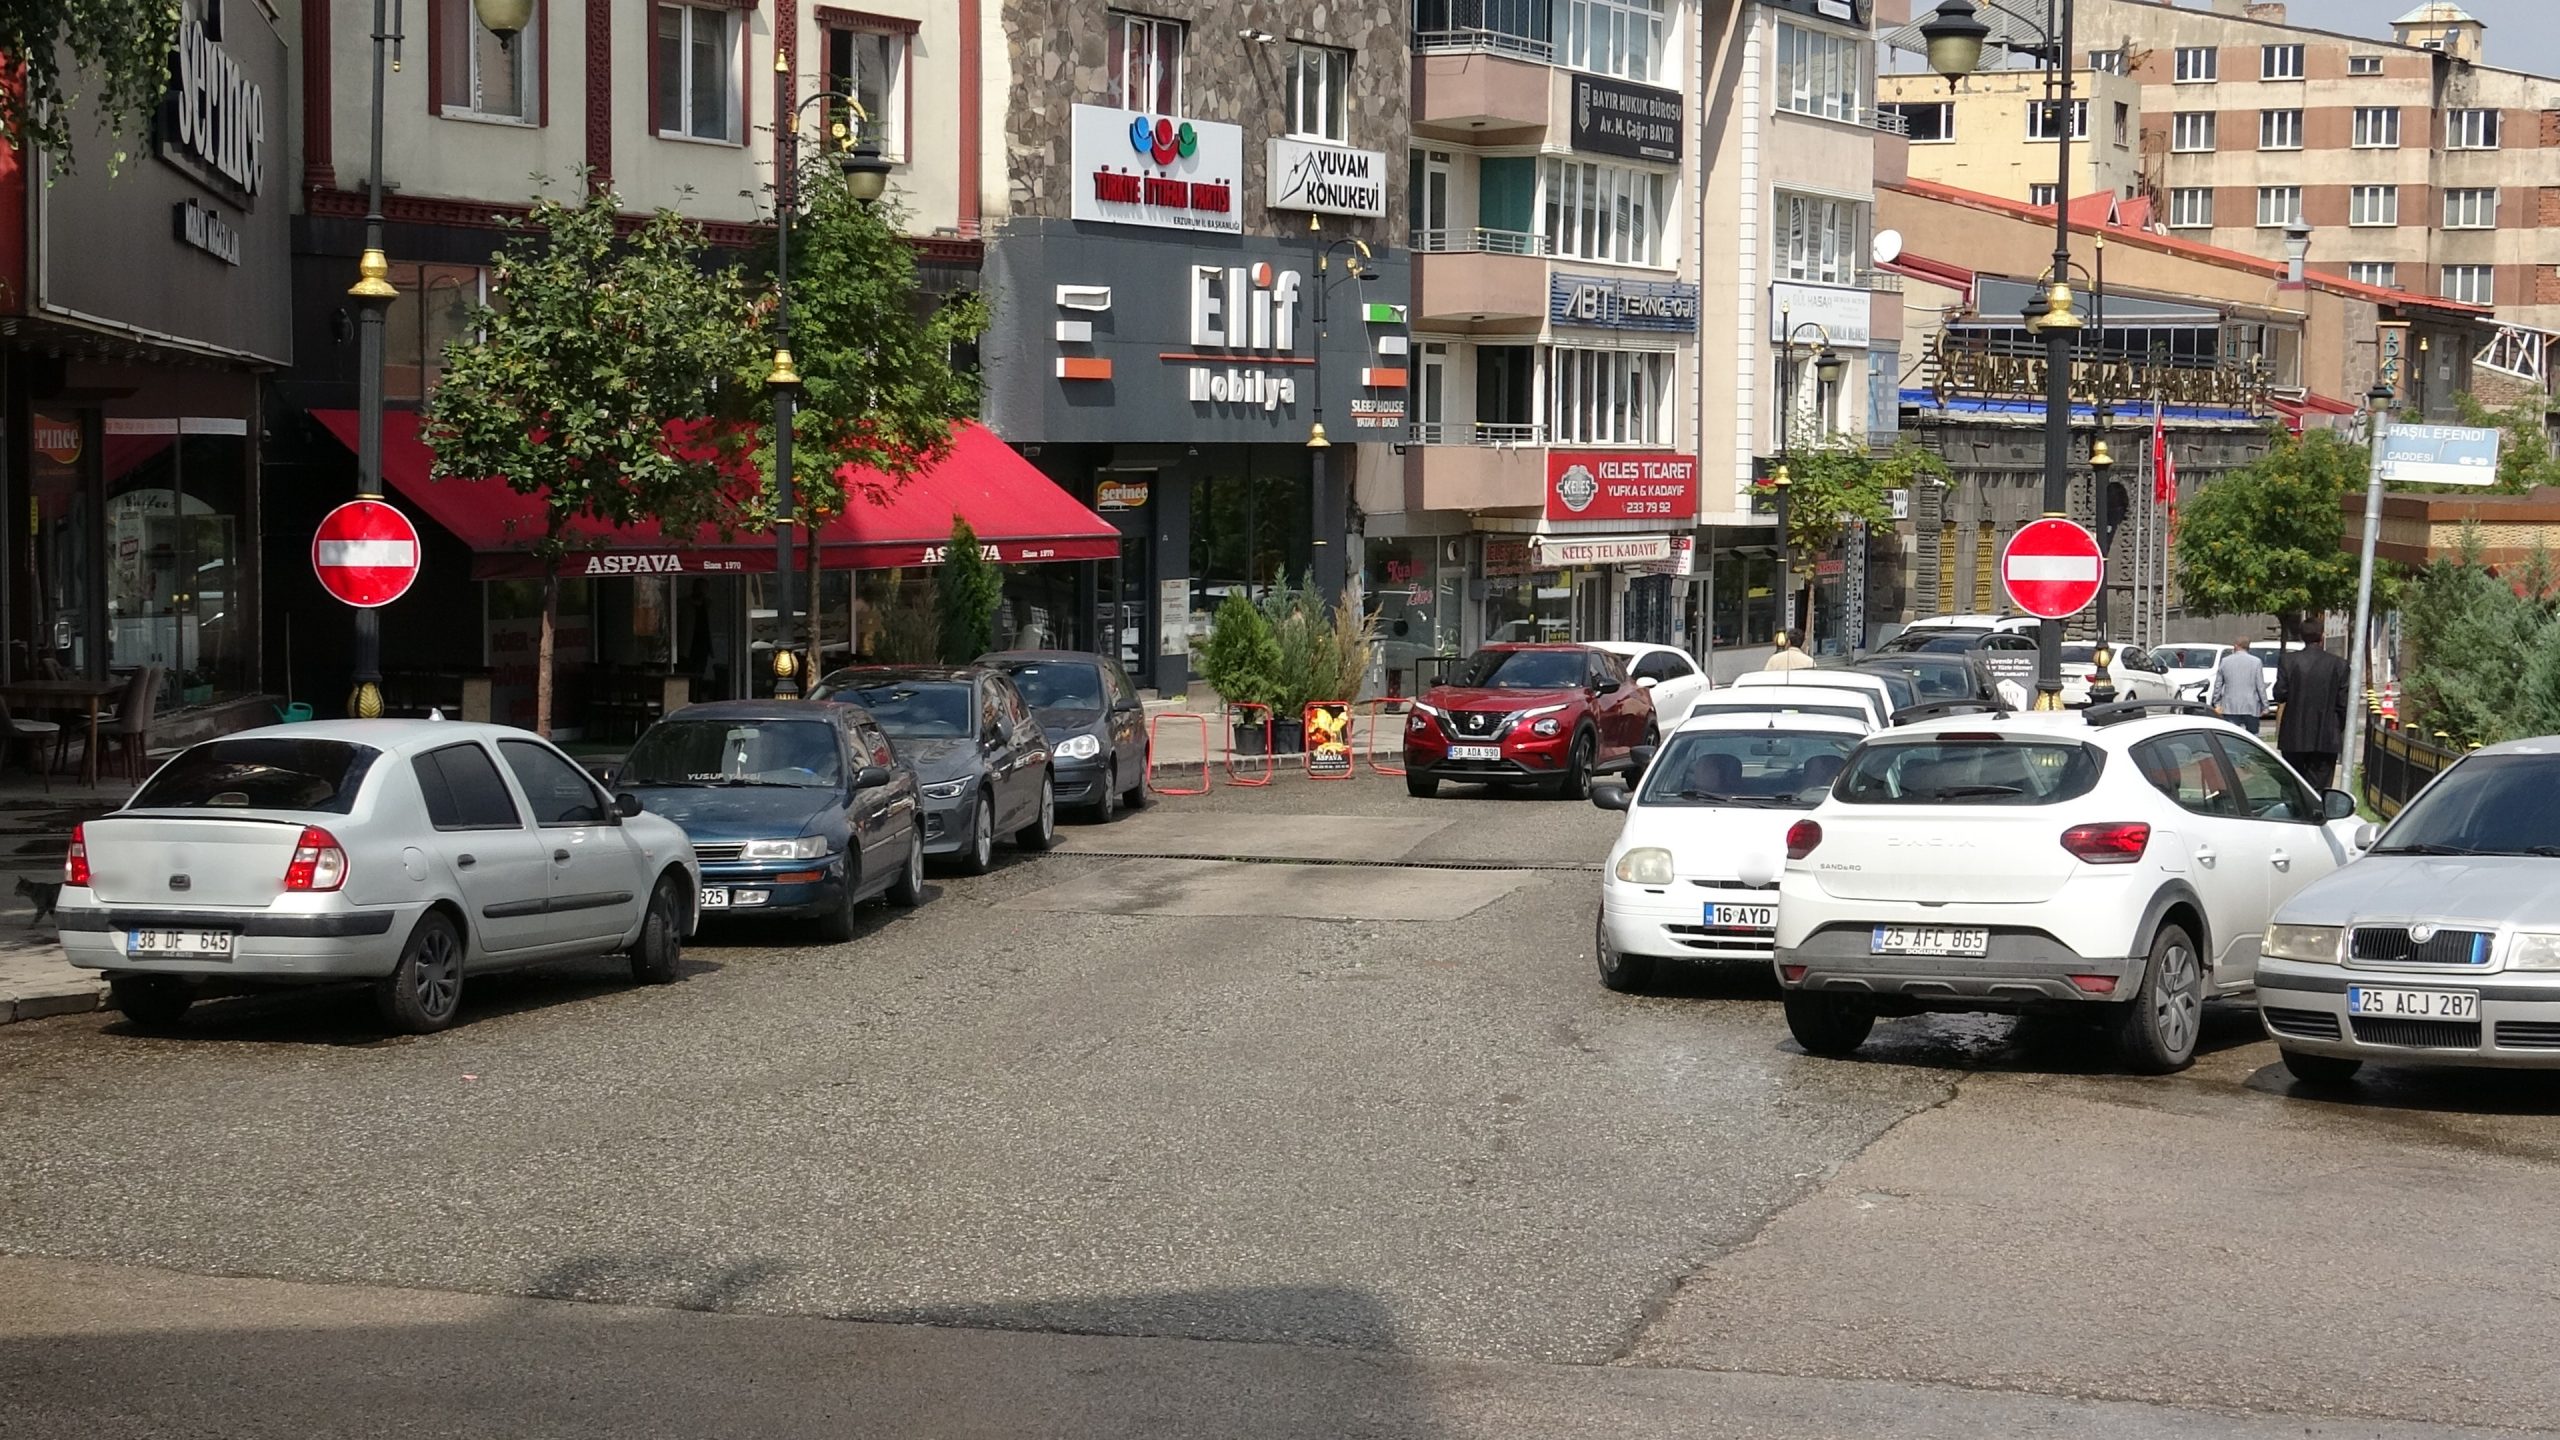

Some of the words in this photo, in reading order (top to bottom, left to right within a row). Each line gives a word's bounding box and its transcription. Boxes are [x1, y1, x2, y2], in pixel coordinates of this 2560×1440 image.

[179, 0, 264, 198] serince
[1592, 89, 1618, 110] BAYIR
[1620, 94, 1648, 115] HUKUK
[1650, 97, 1682, 121] BÜROSU
[1600, 115, 1614, 134] Av.
[1615, 118, 1625, 136] M.
[1626, 120, 1648, 142] Çağrı
[1649, 124, 1674, 144] BAYIR
[1318, 150, 1369, 179] YUVAM
[1093, 165, 1141, 204] TÜRKİYE
[1191, 178, 1230, 213] PARTİSİ
[1307, 181, 1379, 211] KONUKEVİ
[1173, 216, 1201, 228] ERZURUM
[1207, 219, 1240, 231] BAŞKANLIĞI
[1191, 262, 1300, 350] Elif
[1566, 284, 1613, 320] ABT
[1190, 367, 1295, 411] Mobilya
[1351, 399, 1376, 413] SLEEP
[1377, 400, 1404, 413] HOUSE
[2390, 425, 2429, 440] HAŞIL
[1599, 462, 1639, 482] KELEŞ
[1608, 485, 1638, 497] YUFKA
[1648, 485, 1685, 497] KADAYIF
[1626, 502, 1644, 513] 233
[1646, 502, 1657, 513] 79
[1659, 502, 1671, 513] 92
[1562, 546, 1593, 561] KELEŞ
[1596, 544, 1615, 558] TEL
[1617, 543, 1658, 557] KADAYIF
[585, 555, 683, 575] ASPAVA
[703, 560, 722, 571] Since
[725, 560, 741, 571] 1970
[1452, 747, 1463, 756] 58
[1467, 747, 1482, 757] ADA
[1484, 748, 1499, 757] 990
[687, 773, 724, 781] YUSUF
[1820, 863, 1862, 871] SANDERO
[1715, 906, 1732, 924] 16
[1737, 907, 1771, 925] AYD
[139, 930, 156, 949] 38
[166, 931, 184, 949] DF
[200, 932, 229, 950] 645
[1885, 928, 1904, 946] 25
[1913, 928, 1944, 947] AFC
[1952, 930, 1983, 948] 865
[2362, 991, 2384, 1013] 25
[2396, 993, 2429, 1015] ACJ
[2440, 995, 2475, 1016] 287
